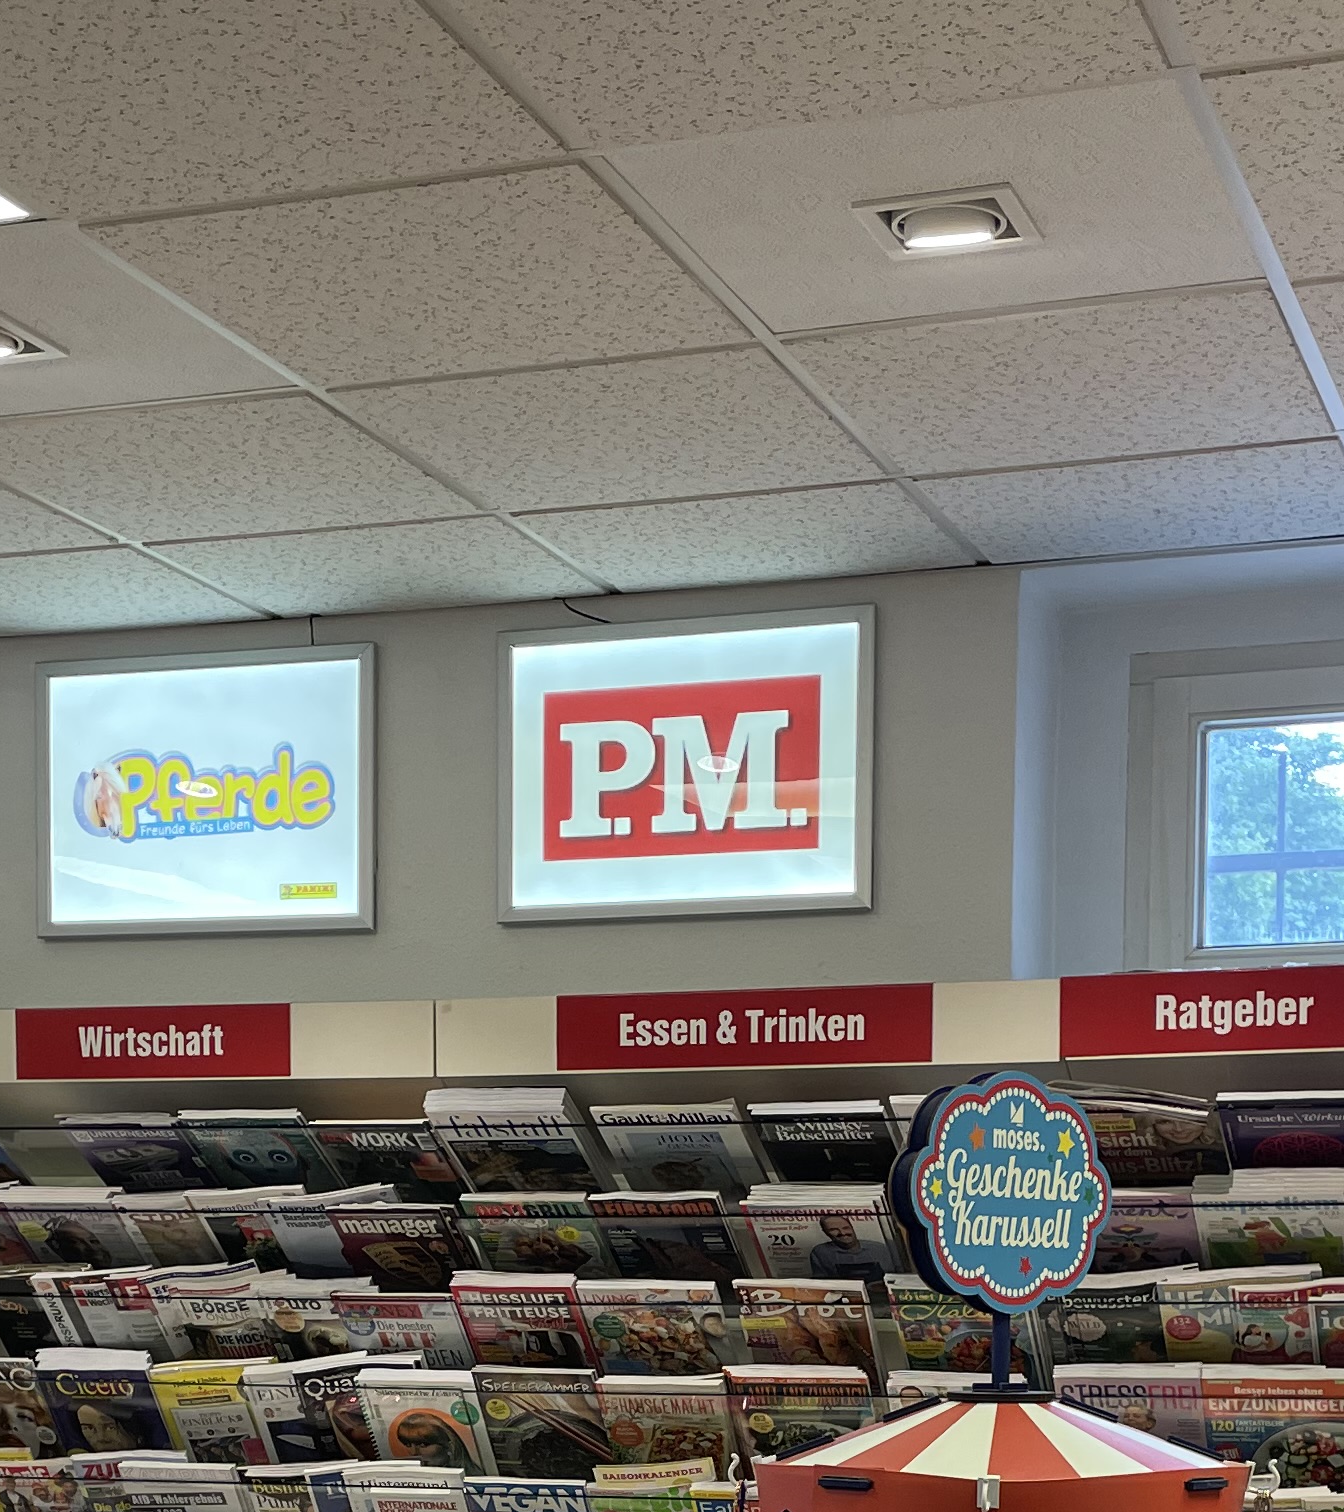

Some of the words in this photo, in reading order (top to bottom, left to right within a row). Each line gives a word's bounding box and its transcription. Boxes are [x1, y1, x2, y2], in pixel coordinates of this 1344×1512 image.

[558, 710, 808, 838] P.M.
[118, 750, 332, 838] Pferde
[140, 823, 186, 837] Freunde
[190, 822, 213, 834] fürs
[217, 820, 250, 832] Leben
[296, 884, 334, 892] PANINI
[619, 1012, 708, 1047] Essen
[716, 1010, 737, 1043] &
[745, 1007, 865, 1044] Trinken
[1155, 993, 1314, 1036] Ratgeber
[78, 1024, 224, 1058] Wirtschaft
[348, 1132, 419, 1151] WORK
[992, 1127, 1046, 1152] moses.
[946, 1148, 1082, 1210] Geschenke
[340, 1214, 443, 1239] manager
[191, 1300, 250, 1317] BÖRSE
[468, 1304, 571, 1320] FRITTEUSE
[55, 1373, 135, 1399] Cicero
[601, 1464, 705, 1483] SAISONKALENDER
